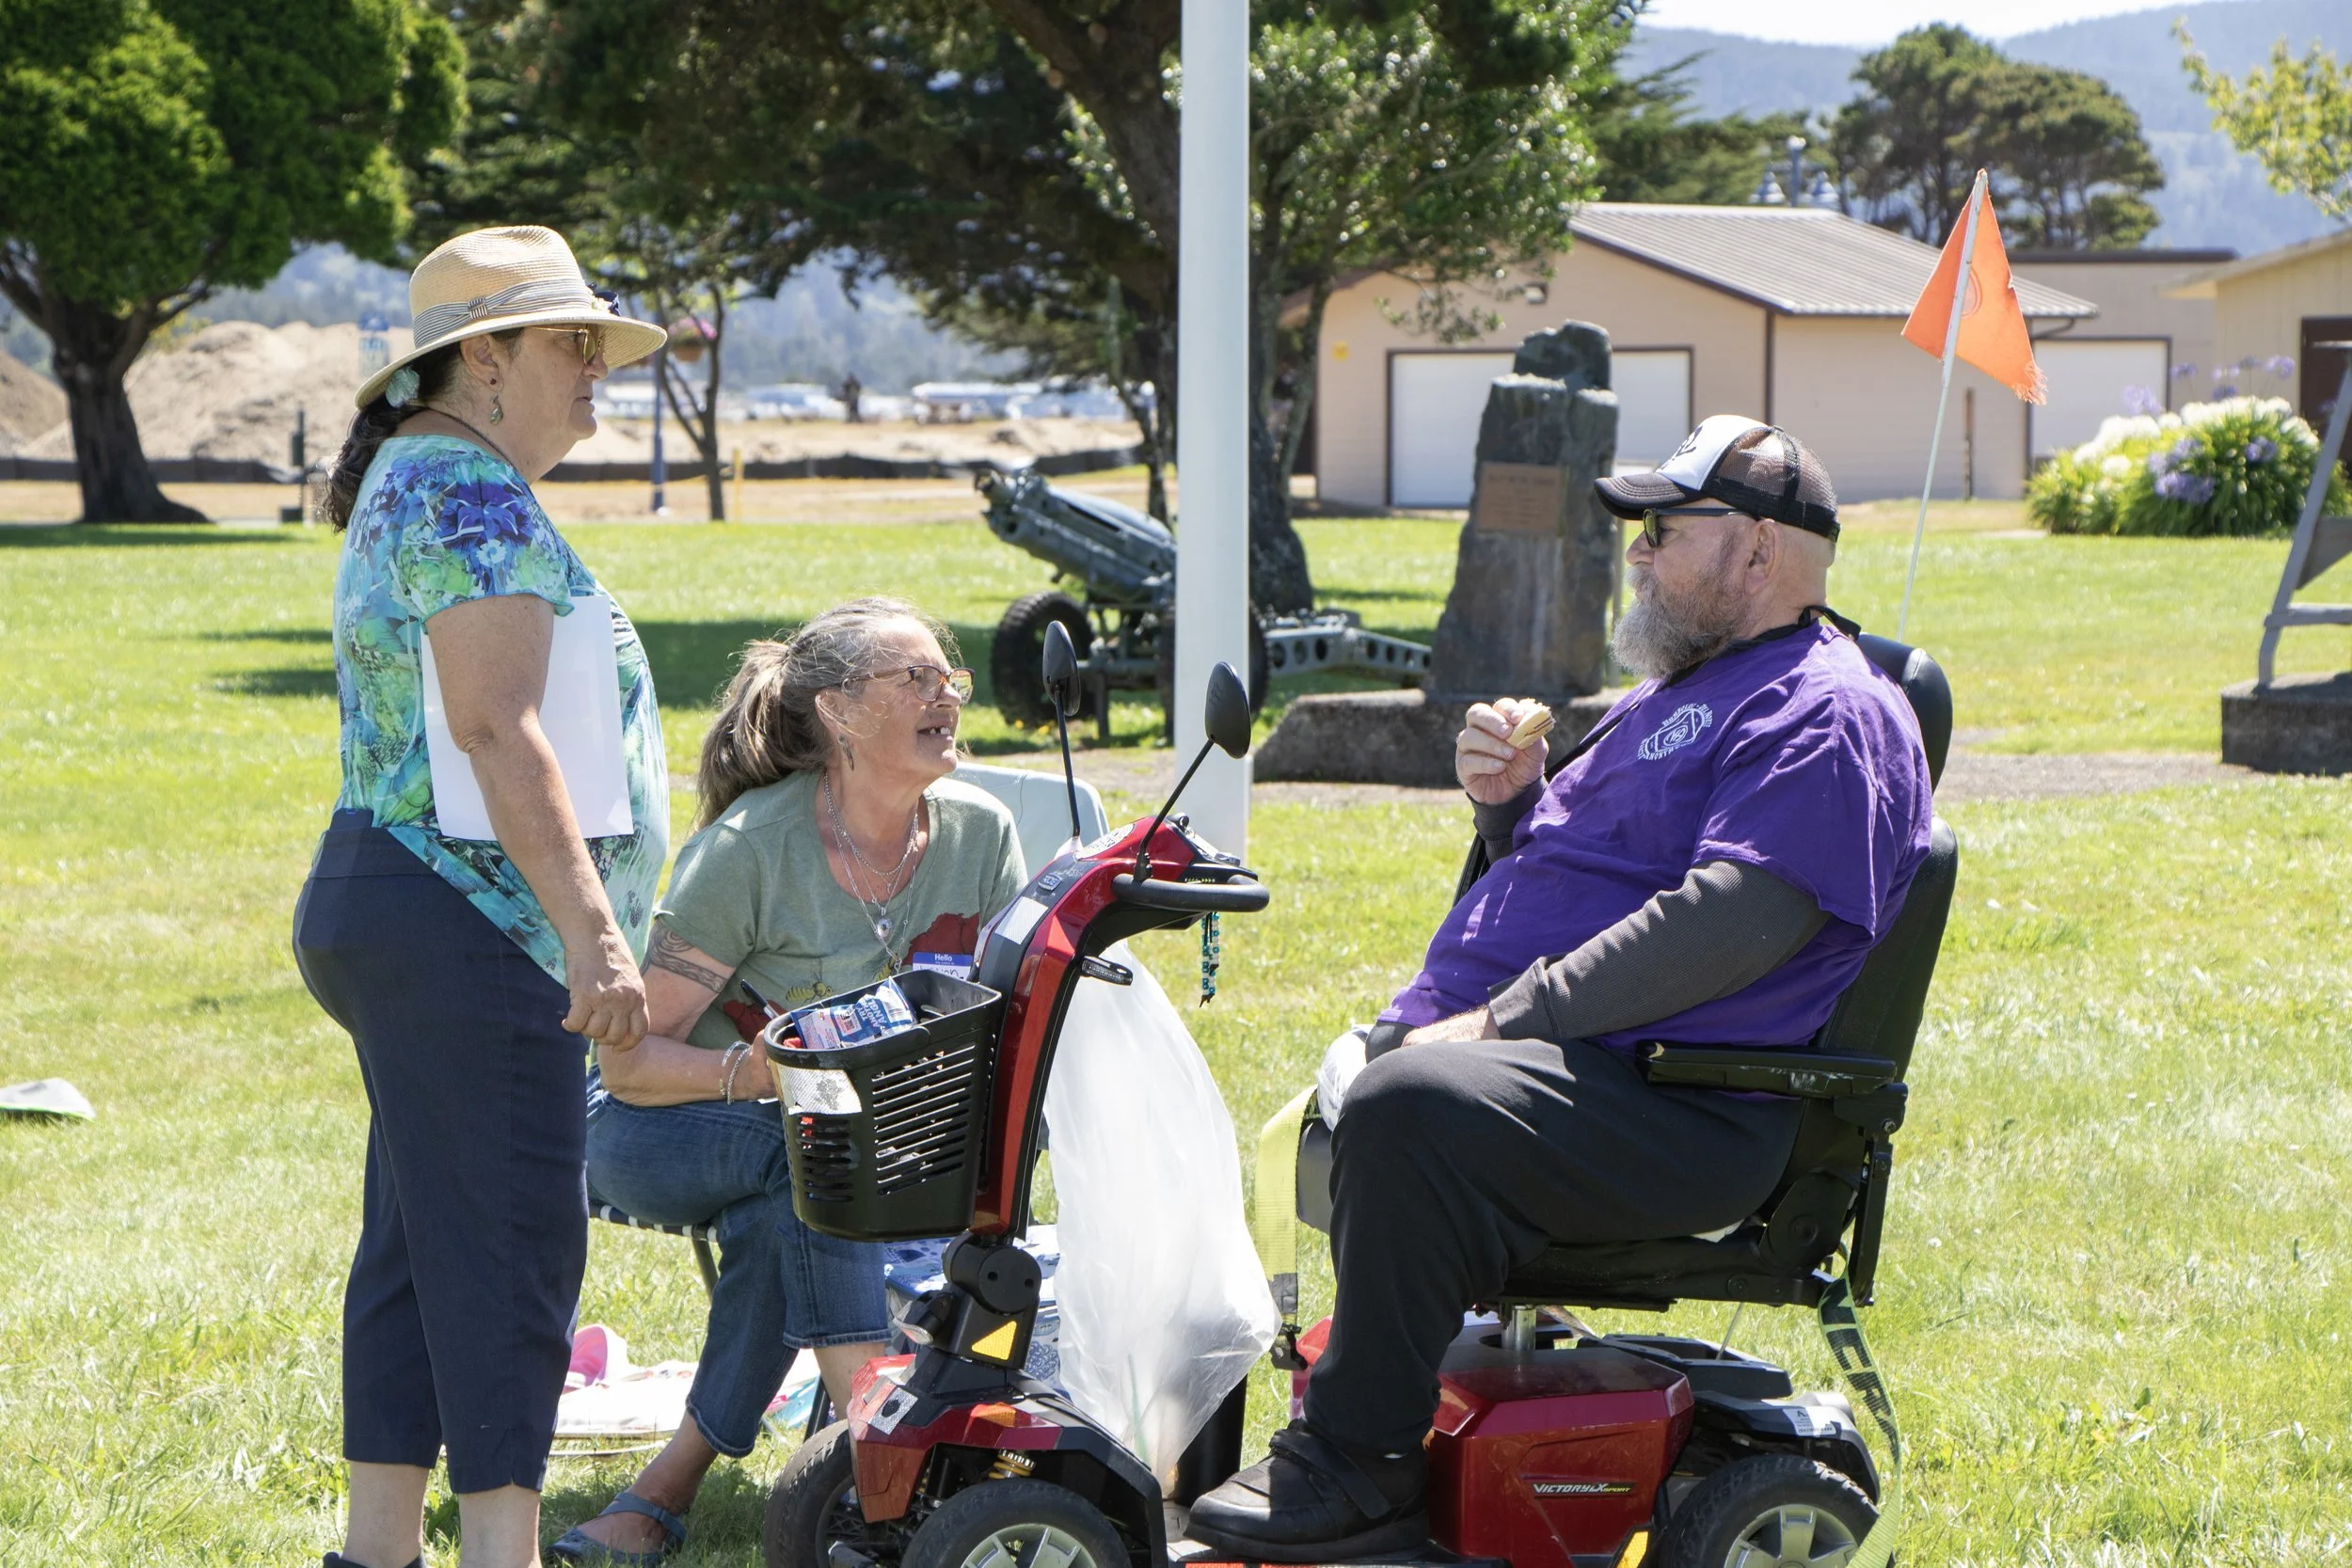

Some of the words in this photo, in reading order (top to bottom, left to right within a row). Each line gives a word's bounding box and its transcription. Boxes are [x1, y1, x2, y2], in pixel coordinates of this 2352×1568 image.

[934, 953, 953, 962] Hello
[857, 1006, 868, 1022] TRY
[862, 1002, 881, 1027] ANOTH
[868, 998, 887, 1023] ANGL
